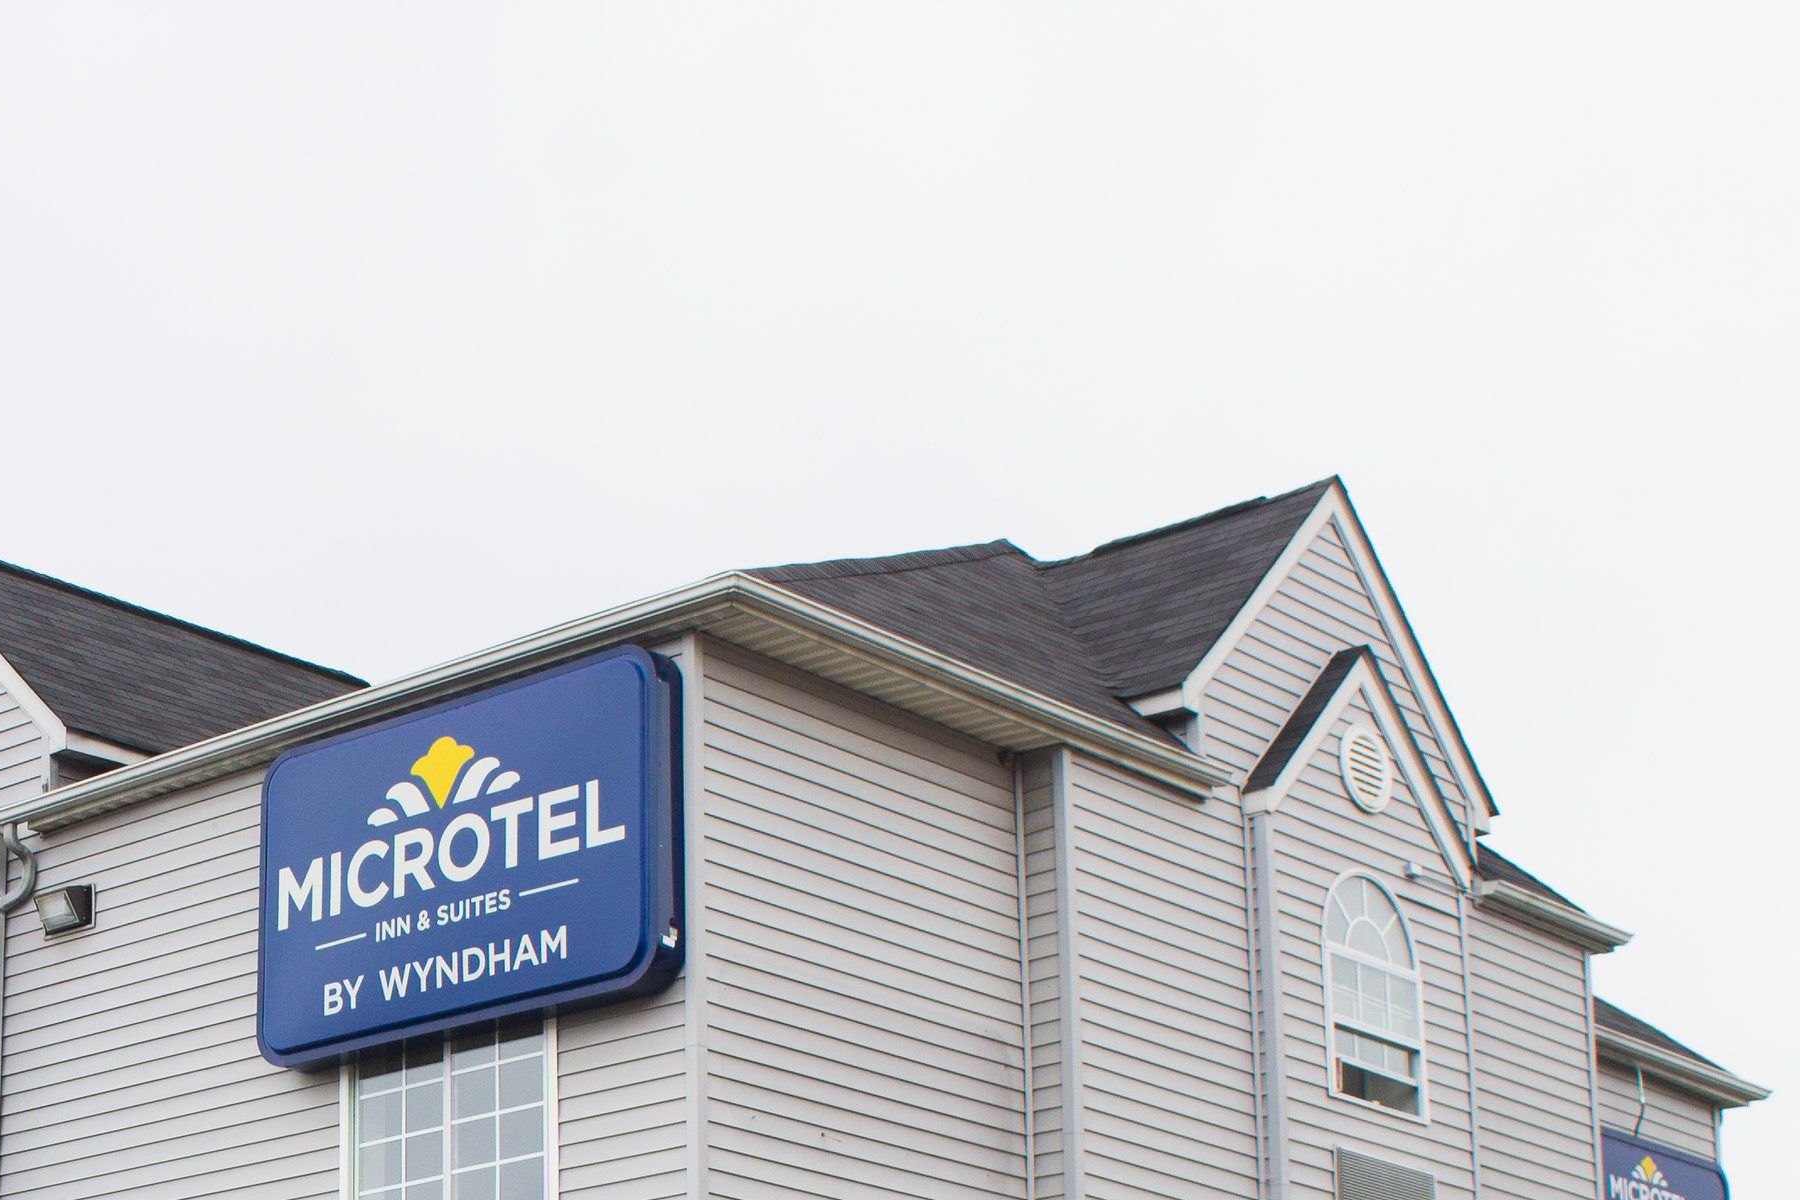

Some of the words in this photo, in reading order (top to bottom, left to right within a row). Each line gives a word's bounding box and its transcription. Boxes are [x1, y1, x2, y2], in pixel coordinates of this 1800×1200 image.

[277, 779, 626, 932] MICROTEL
[375, 914, 411, 942] INN
[416, 909, 431, 931] &
[436, 888, 511, 926] SUITES
[323, 975, 365, 1017] BY
[379, 925, 568, 1001] WYNDHAM
